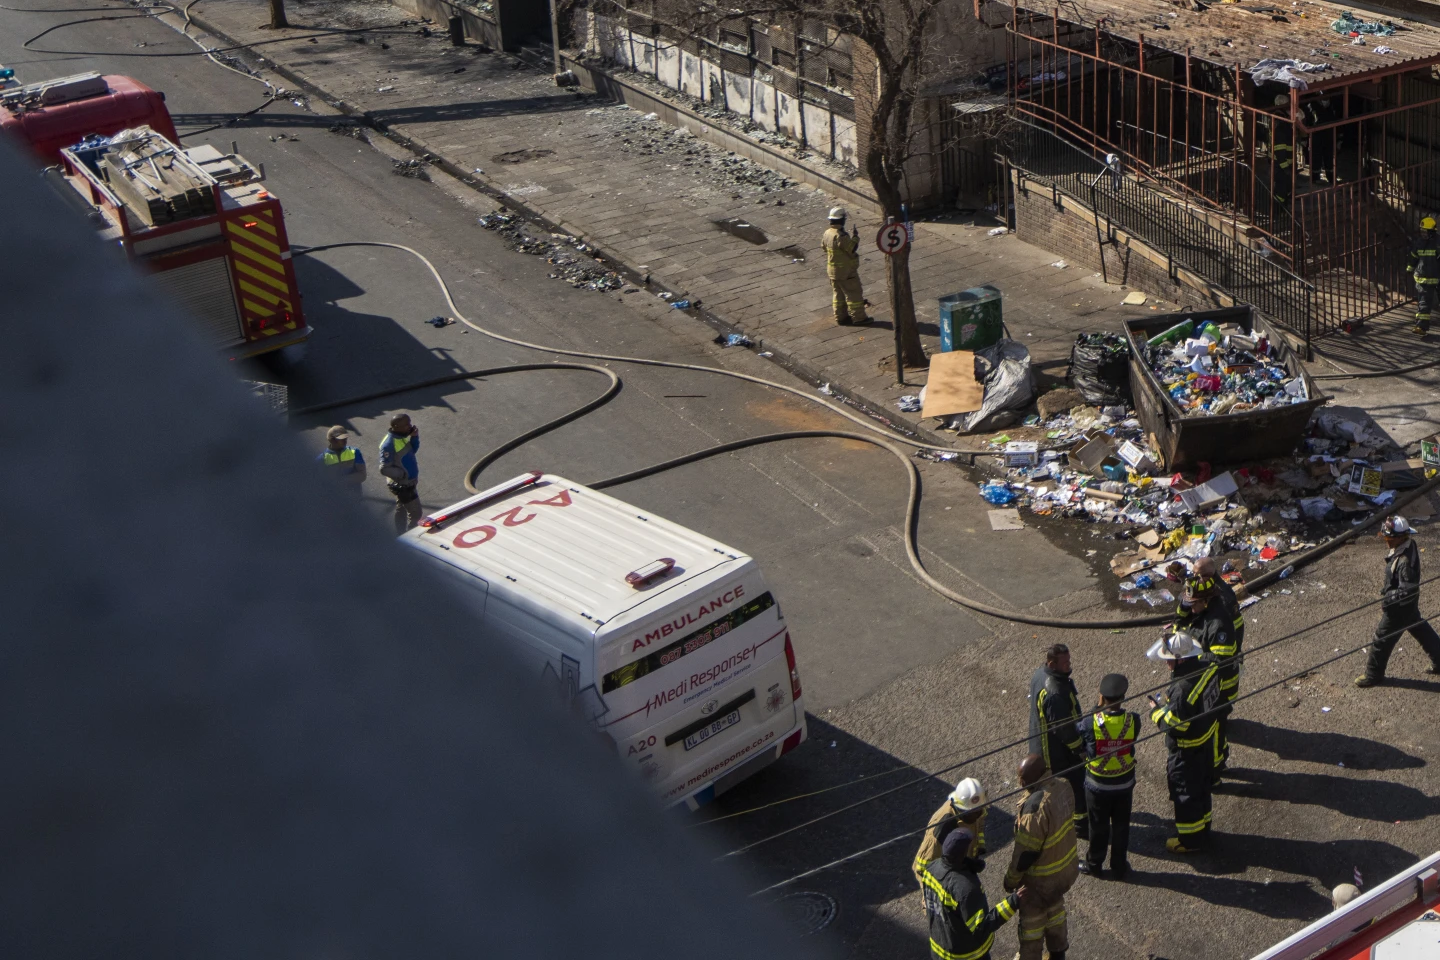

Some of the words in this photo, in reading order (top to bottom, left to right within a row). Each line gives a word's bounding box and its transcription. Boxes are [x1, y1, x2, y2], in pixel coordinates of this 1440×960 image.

[453, 489, 573, 549] A20
[631, 584, 746, 653] AMBULANCE
[653, 680, 687, 710] Medi
[690, 647, 751, 691] Response
[683, 685, 713, 705] Emergency
[713, 675, 733, 689] Medical
[733, 663, 752, 678] Service
[628, 734, 657, 758] A20
[687, 730, 775, 787] mediresponse.co.za
